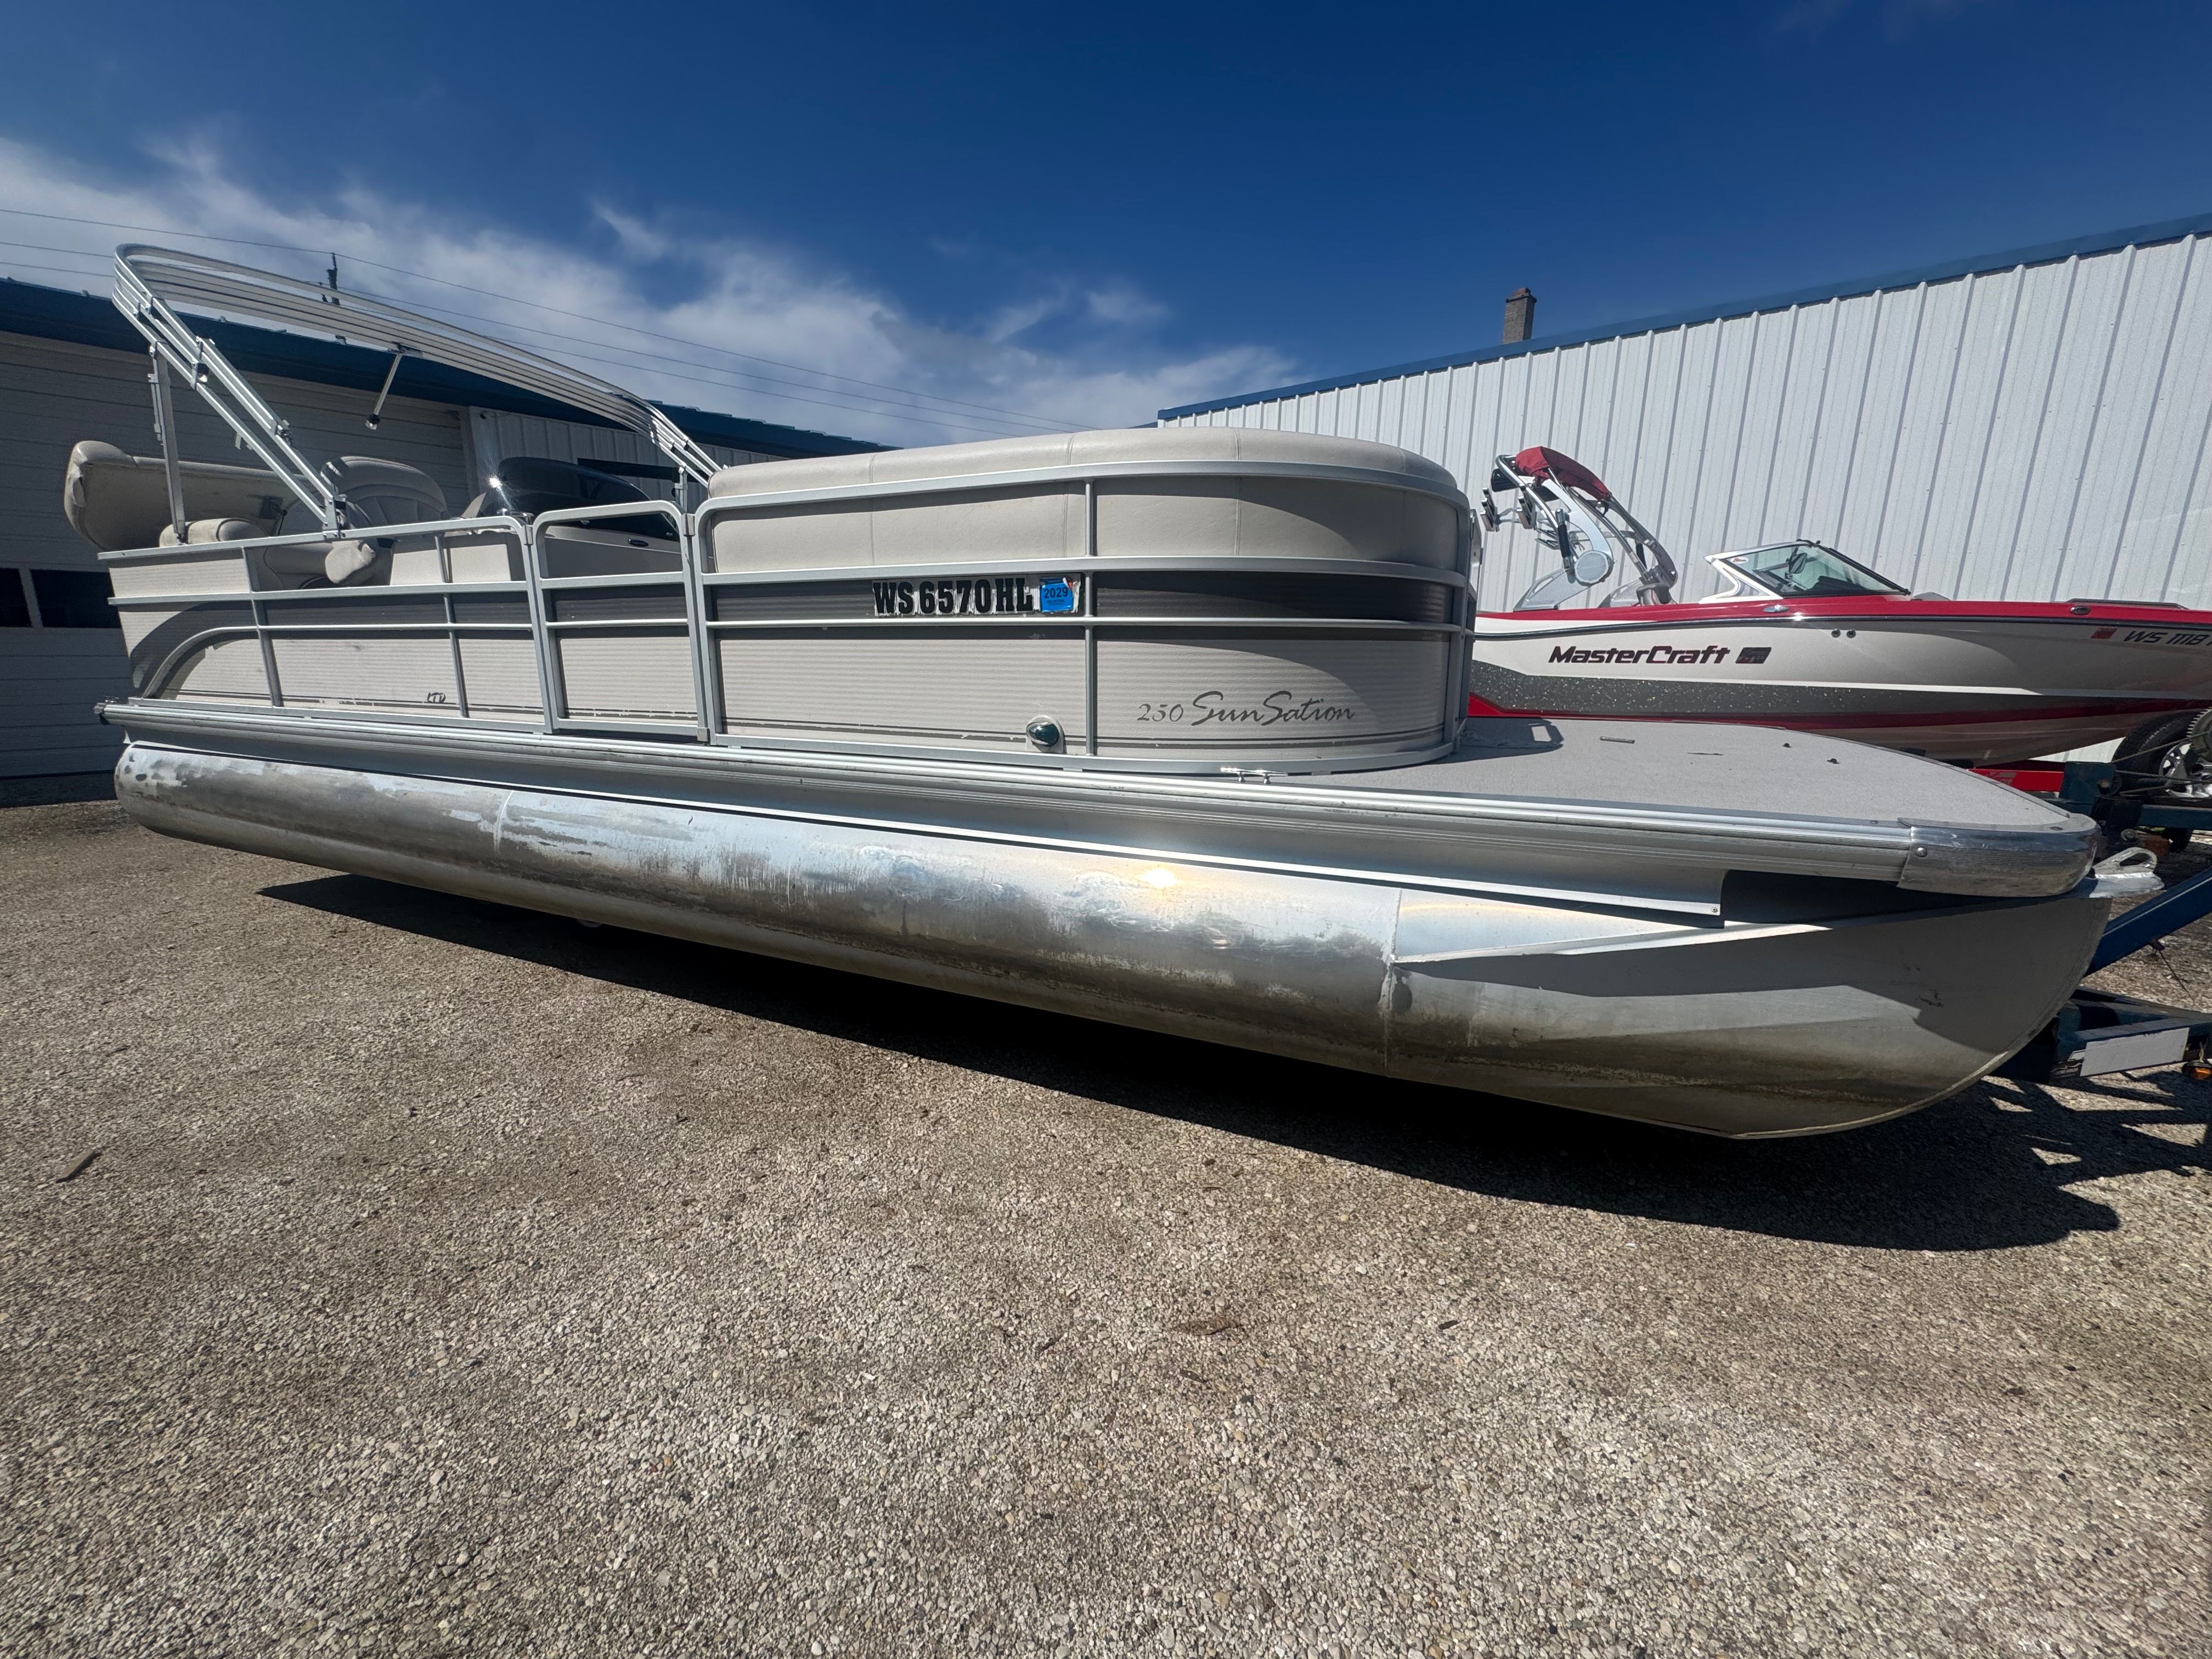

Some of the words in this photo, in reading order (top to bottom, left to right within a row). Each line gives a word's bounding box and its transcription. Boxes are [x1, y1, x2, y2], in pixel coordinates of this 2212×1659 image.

[873, 582, 913, 614] WS
[1044, 586, 1068, 599] 2029
[2123, 630, 2168, 643] WS
[1548, 645, 1731, 664] MasterCraft
[1137, 704, 1184, 722] 250
[1191, 691, 1355, 726] SunSation
